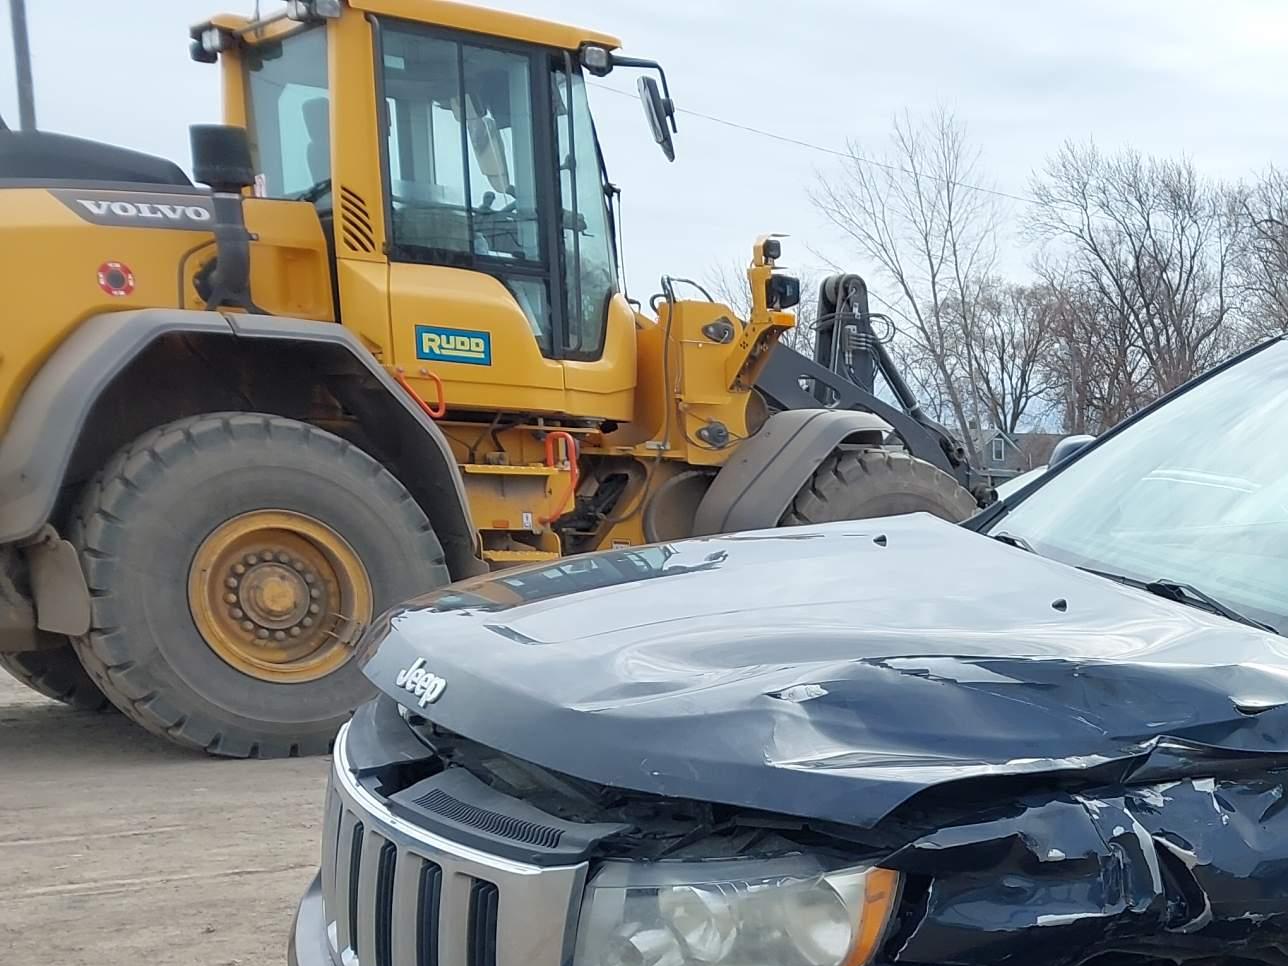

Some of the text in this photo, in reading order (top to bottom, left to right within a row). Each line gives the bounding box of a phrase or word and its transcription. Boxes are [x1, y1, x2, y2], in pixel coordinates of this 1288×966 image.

[77, 199, 210, 221] VOLVO
[422, 332, 485, 355] RUDD
[396, 657, 447, 708] Jeep
